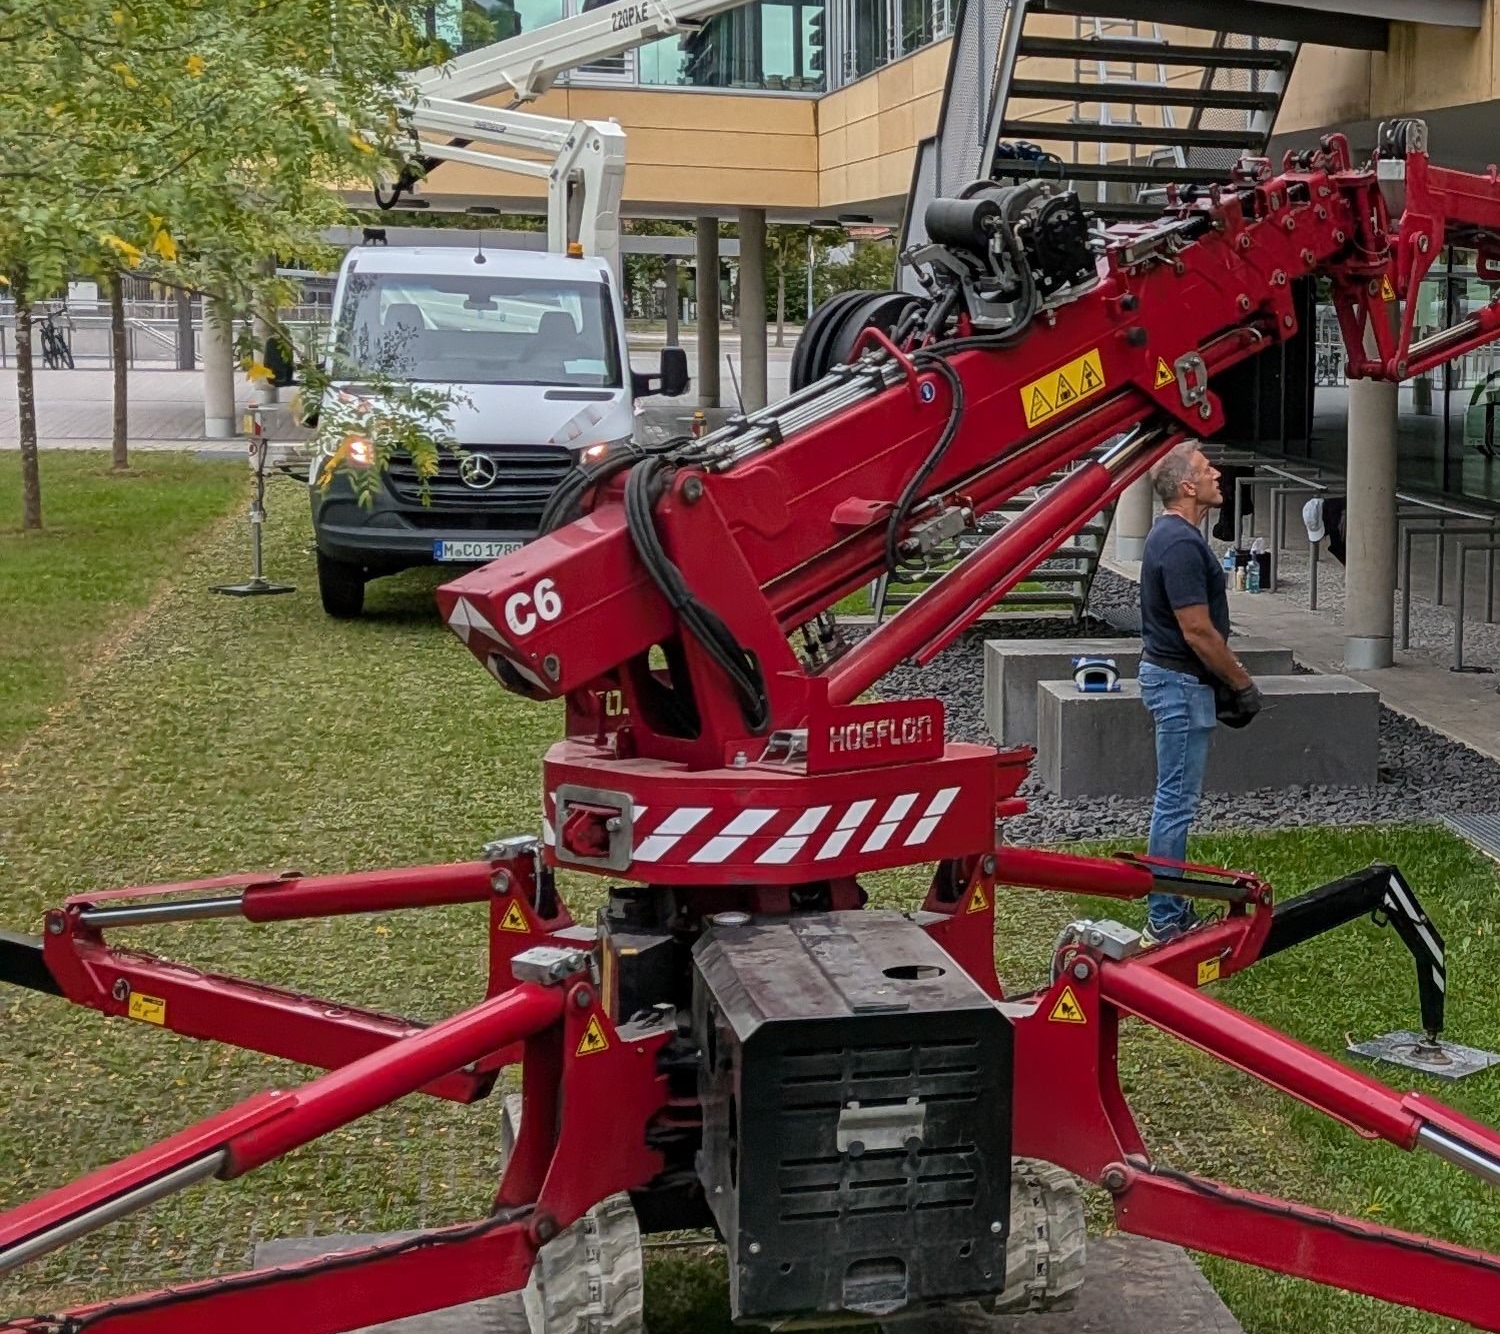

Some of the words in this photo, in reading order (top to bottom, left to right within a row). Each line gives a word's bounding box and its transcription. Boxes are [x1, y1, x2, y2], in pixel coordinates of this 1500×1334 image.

[444, 543, 454, 557] M
[463, 543, 482, 557] CO
[505, 578, 562, 636] C6
[829, 714, 932, 753] HOEFLON
